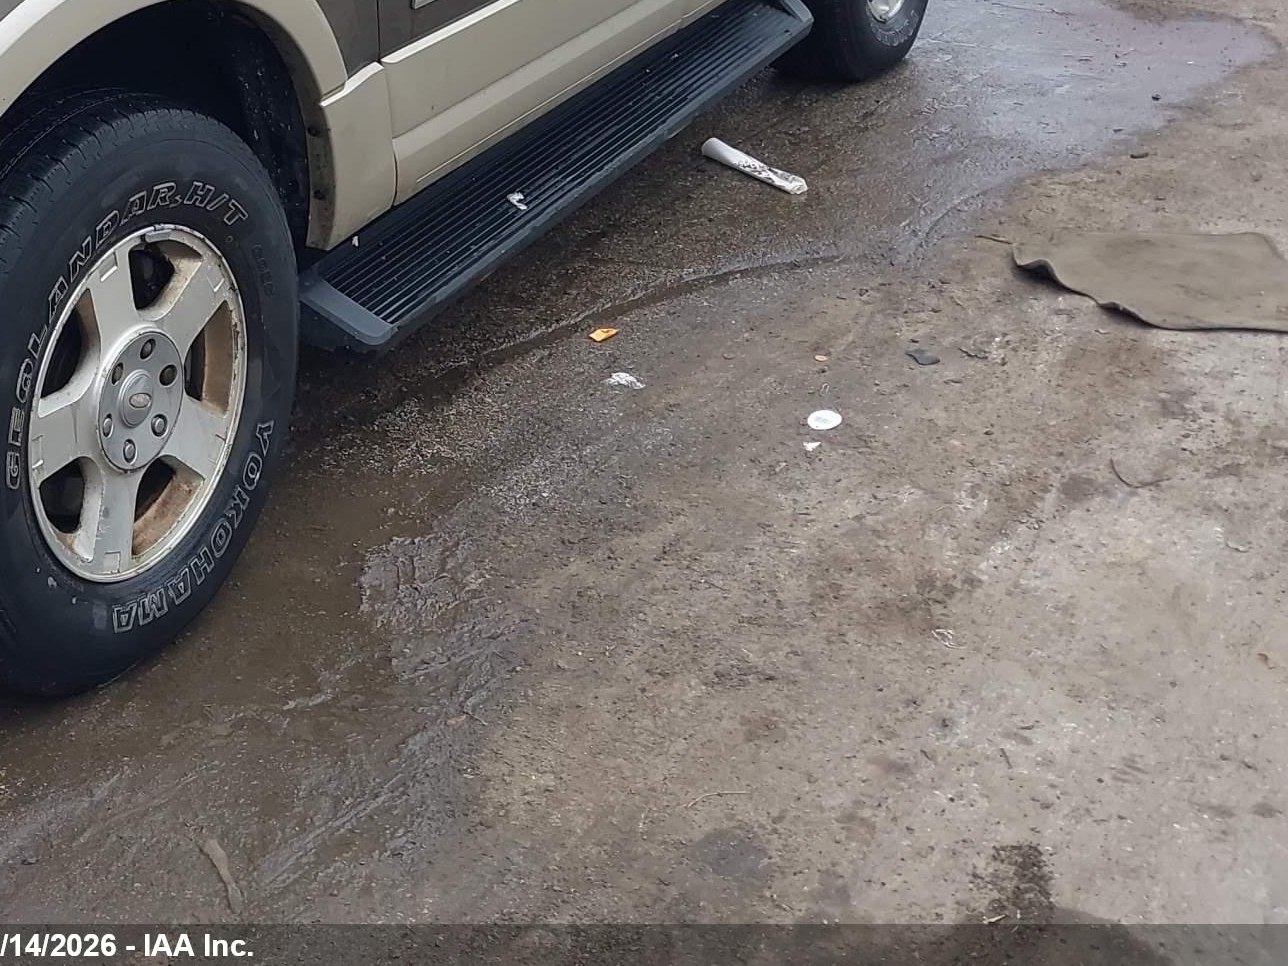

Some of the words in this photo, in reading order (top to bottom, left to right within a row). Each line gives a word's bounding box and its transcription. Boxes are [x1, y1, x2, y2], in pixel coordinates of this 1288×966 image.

[5, 182, 177, 491] GEOLANDAR
[183, 181, 249, 225] H/T
[112, 419, 275, 634] YOKOHAMA
